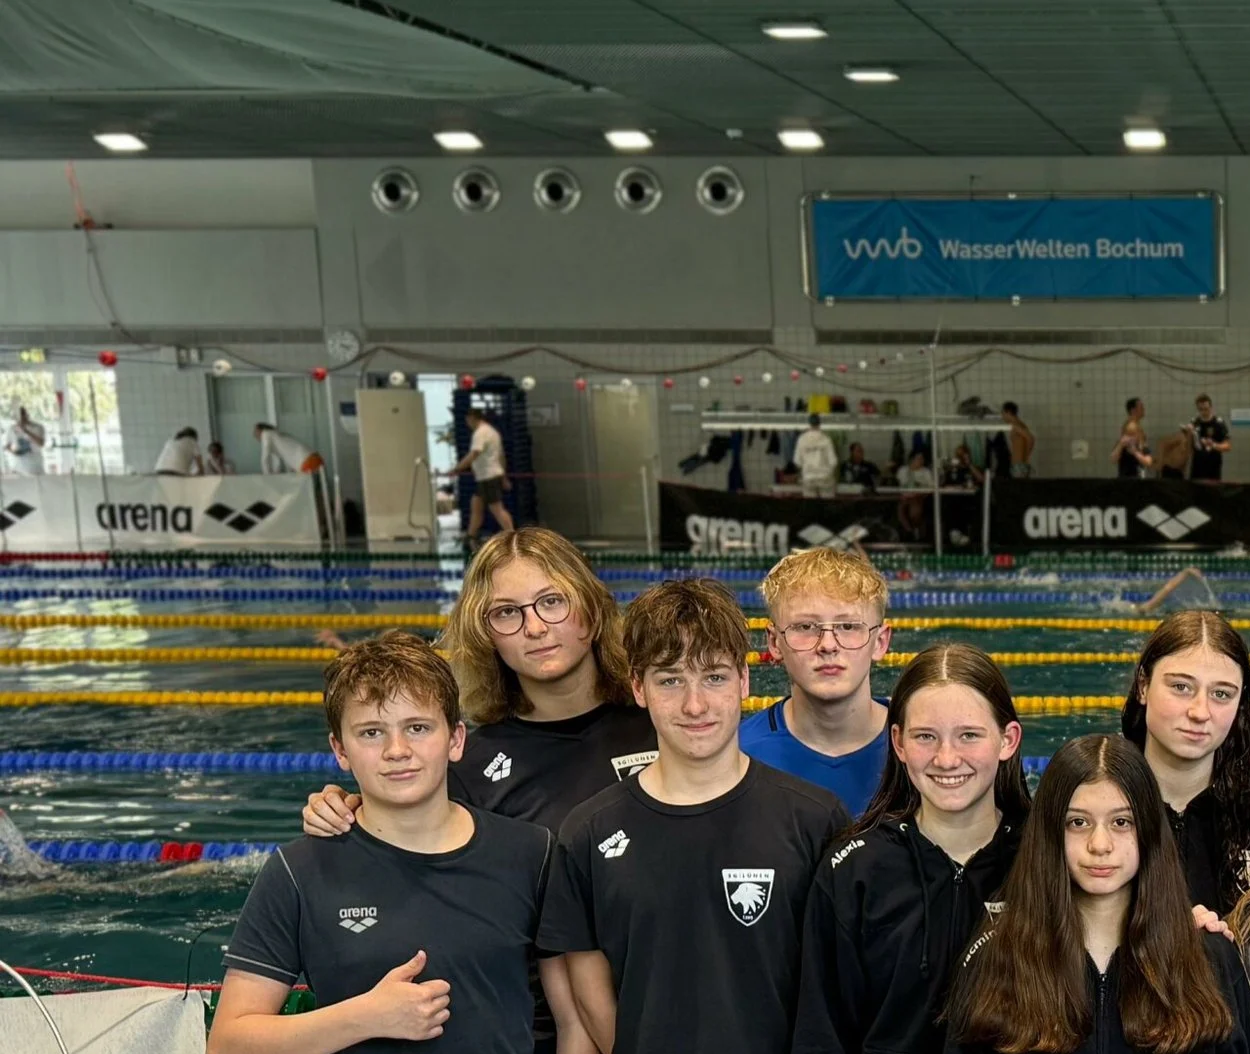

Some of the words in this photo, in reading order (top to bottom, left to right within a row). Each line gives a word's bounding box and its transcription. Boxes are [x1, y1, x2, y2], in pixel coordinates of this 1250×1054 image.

[938, 238, 1090, 259] WasserWelten
[1095, 237, 1185, 259] Bochum
[96, 502, 193, 533] arena
[1023, 505, 1128, 539] arena
[686, 514, 789, 554] arena
[483, 752, 507, 777] arena
[598, 829, 627, 853] arena
[830, 838, 866, 869] Alexia
[339, 906, 378, 919] arena
